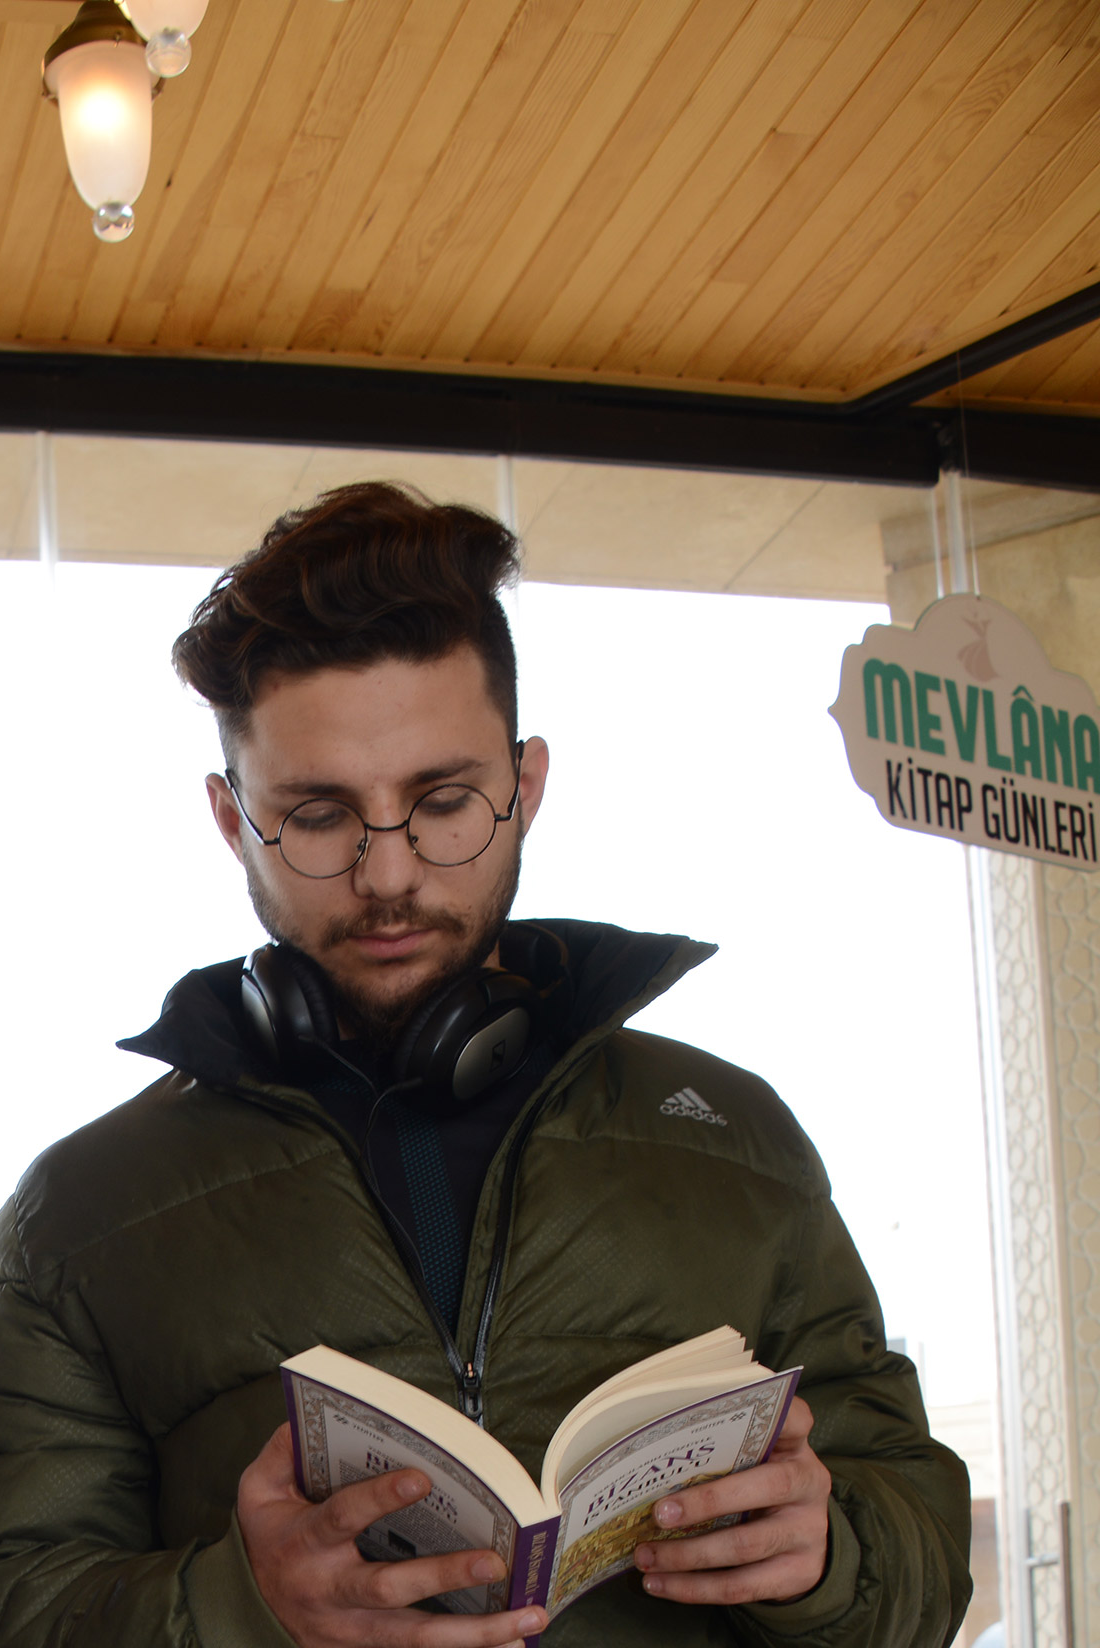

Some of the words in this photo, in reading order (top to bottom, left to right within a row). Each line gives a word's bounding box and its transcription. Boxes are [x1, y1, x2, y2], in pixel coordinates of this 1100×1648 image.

[862, 657, 1100, 795] MEVLÂNA
[886, 757, 973, 832] KİTAP
[981, 778, 1098, 863] GÜNLERİ
[659, 1103, 729, 1127] adidas
[586, 1440, 717, 1515] BİZANS
